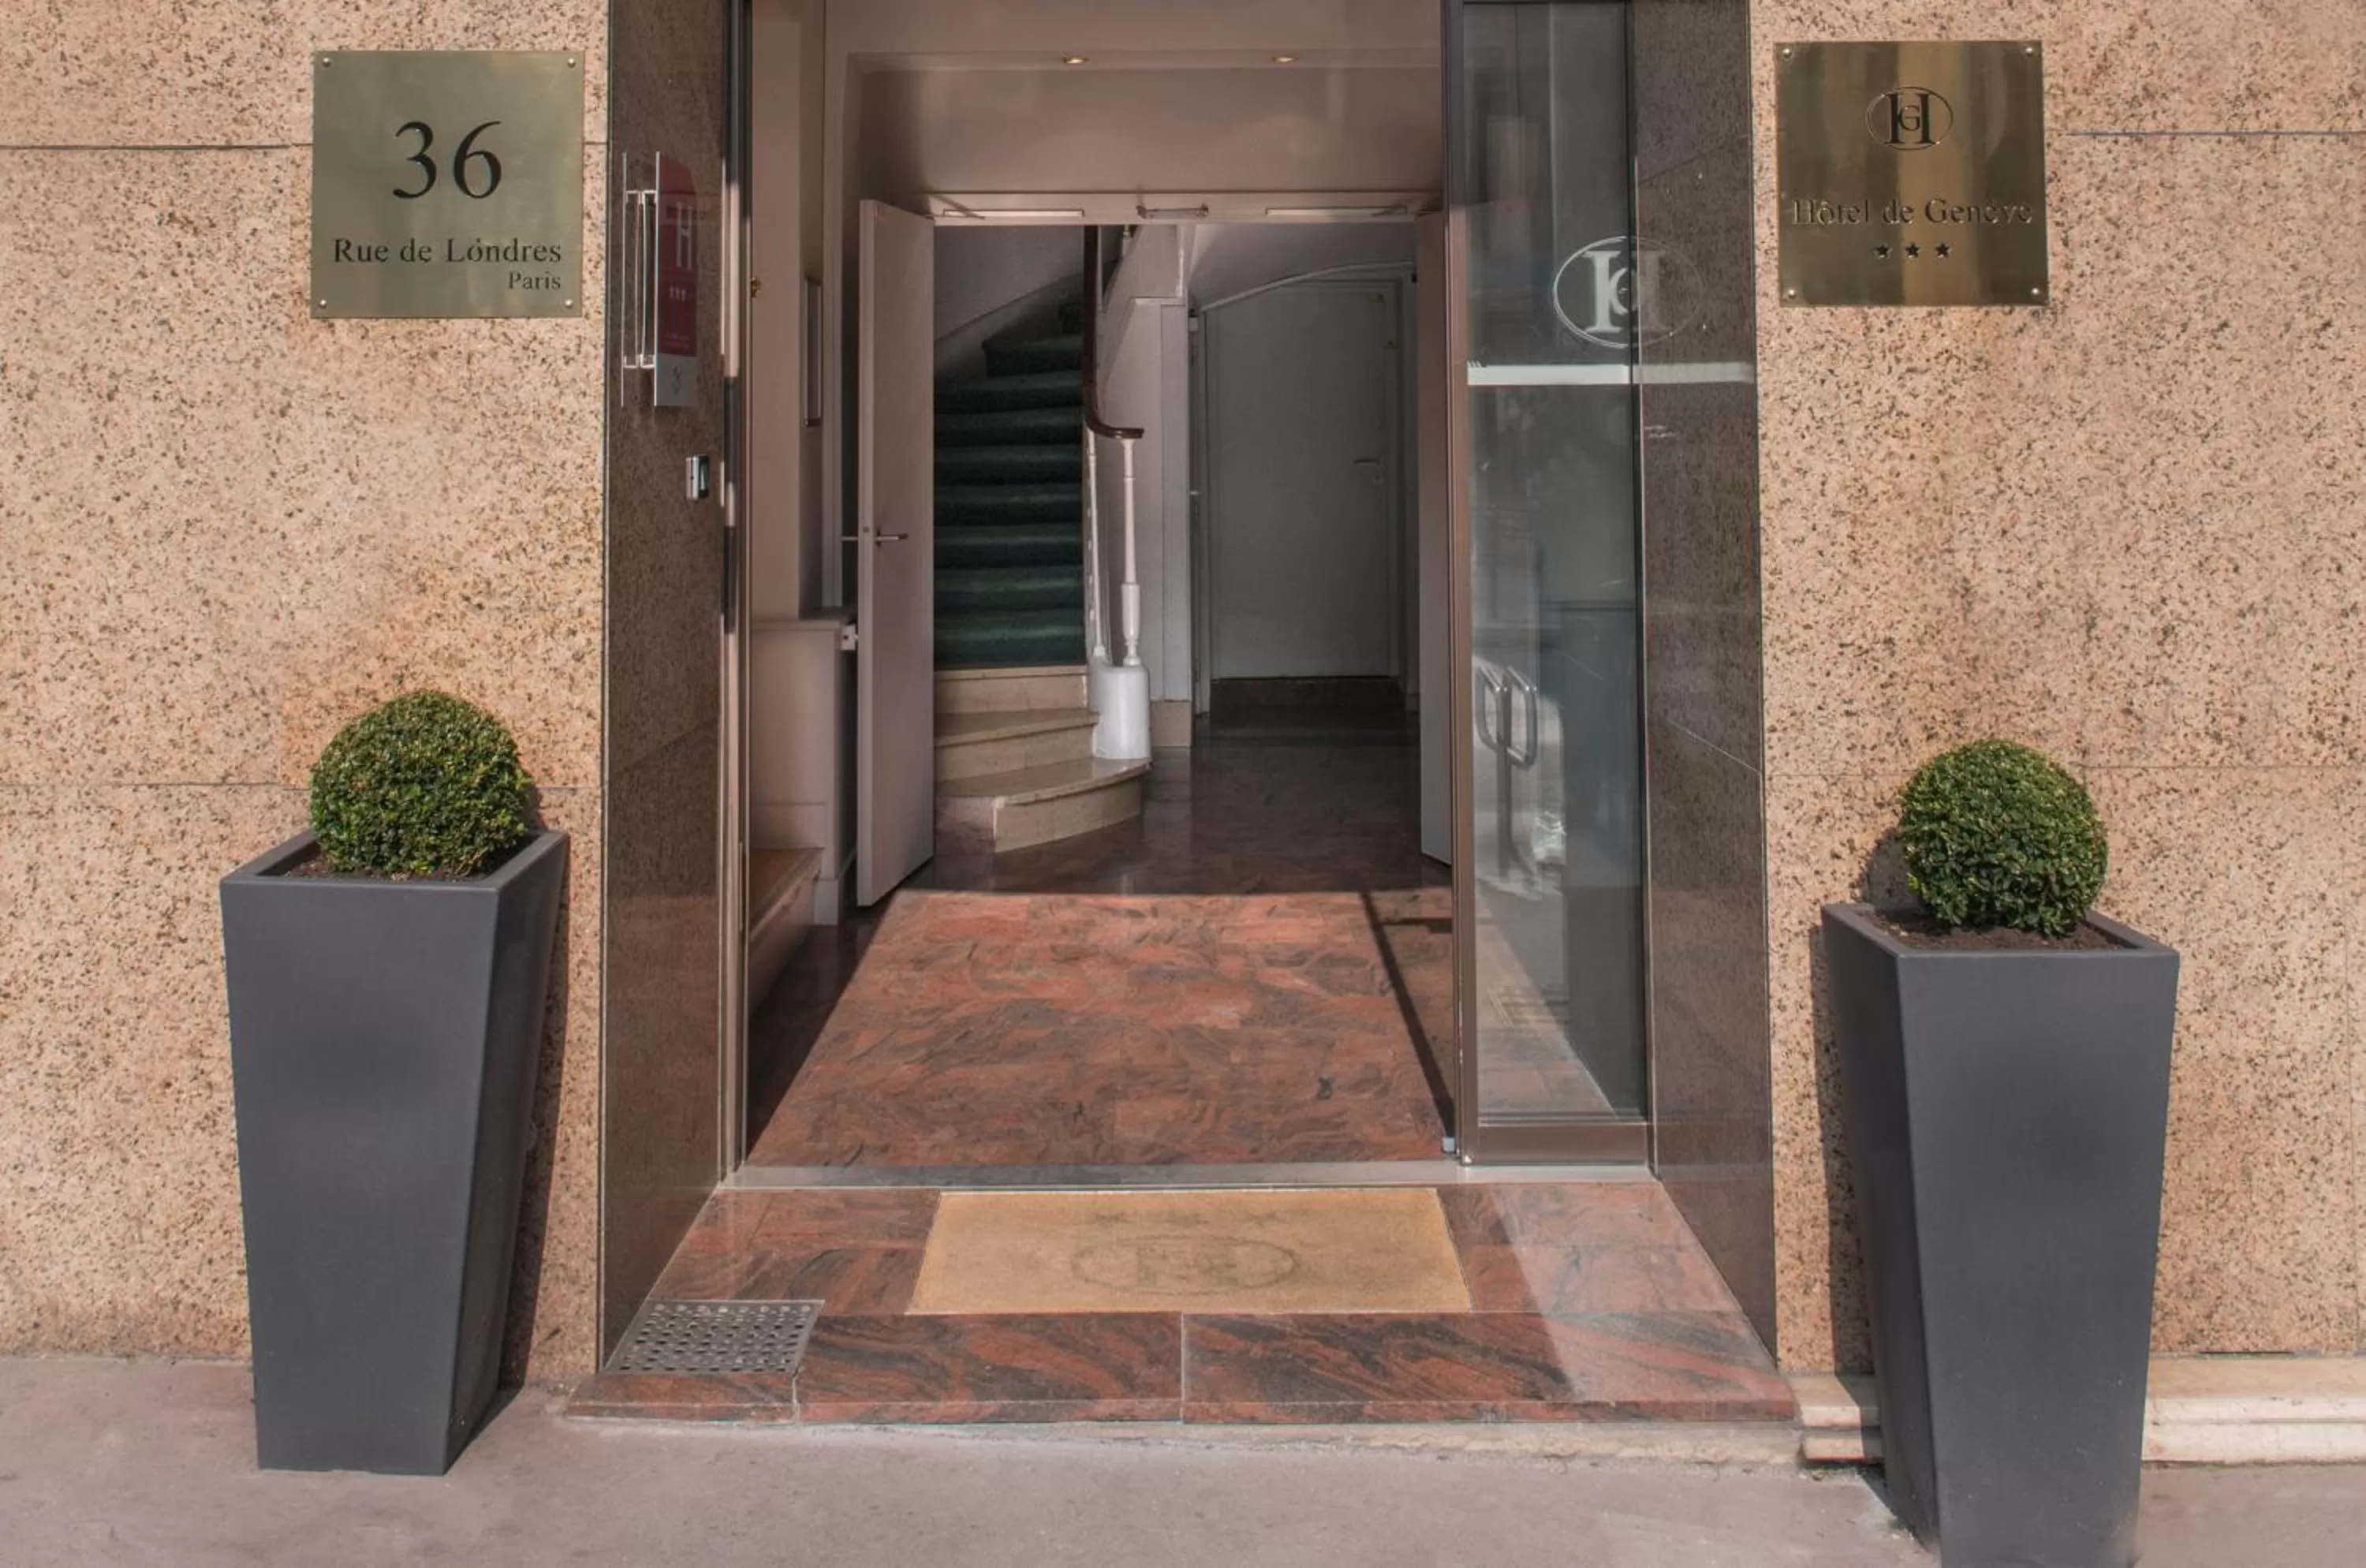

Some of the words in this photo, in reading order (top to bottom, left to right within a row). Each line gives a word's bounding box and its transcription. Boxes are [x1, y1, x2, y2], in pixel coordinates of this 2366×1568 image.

[393, 121, 502, 200] 36
[1793, 198, 1869, 226] Hôtel
[1883, 198, 1914, 225] de
[1924, 197, 2033, 224] Genève
[334, 237, 389, 263] Rue
[400, 237, 432, 263] de
[507, 271, 562, 290] Paris
